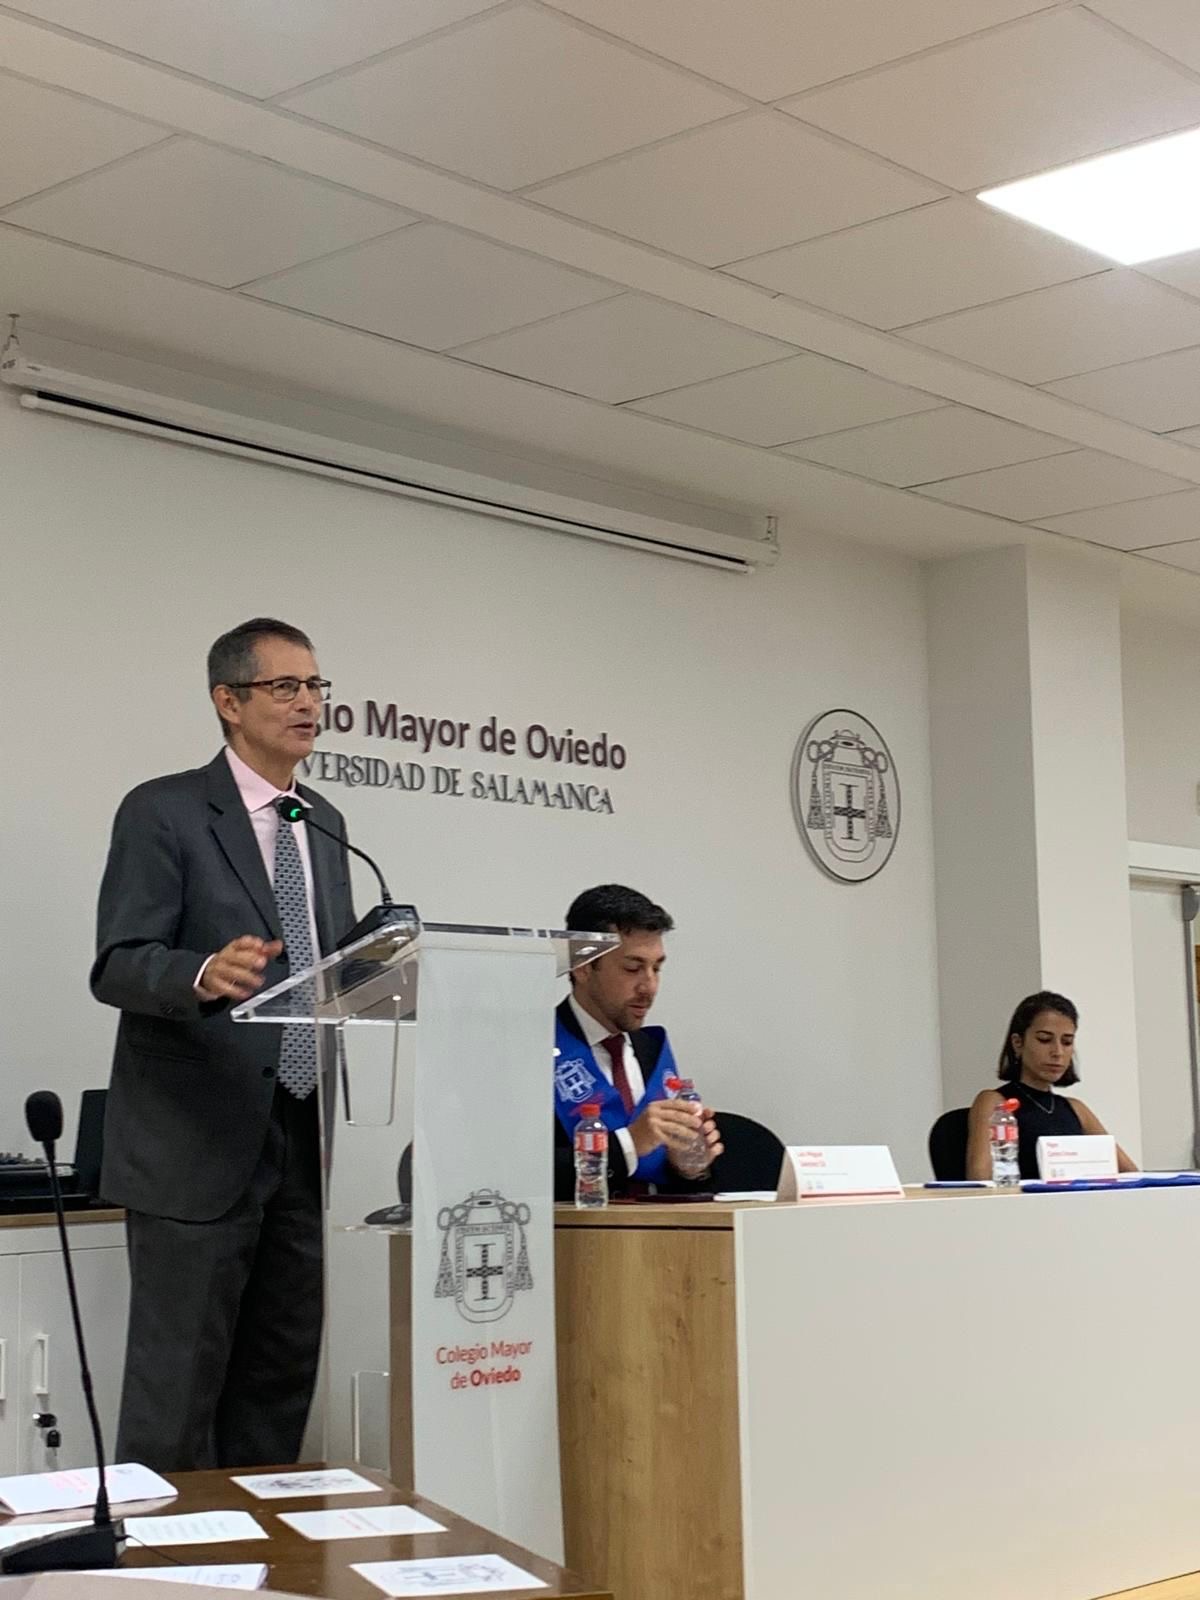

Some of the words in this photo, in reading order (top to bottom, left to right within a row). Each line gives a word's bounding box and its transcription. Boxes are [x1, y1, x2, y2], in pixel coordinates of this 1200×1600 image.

[365, 699, 470, 754] Mayor
[479, 716, 517, 756] de
[525, 723, 627, 770] Oviedo
[300, 750, 426, 792] VERSIDAD
[430, 765, 465, 797] DE
[470, 770, 615, 814] SALAMANCA
[436, 1344, 488, 1365] Colegio
[490, 1340, 533, 1359] Mayor
[450, 1371, 468, 1390] de
[470, 1364, 521, 1387] Oviedo
